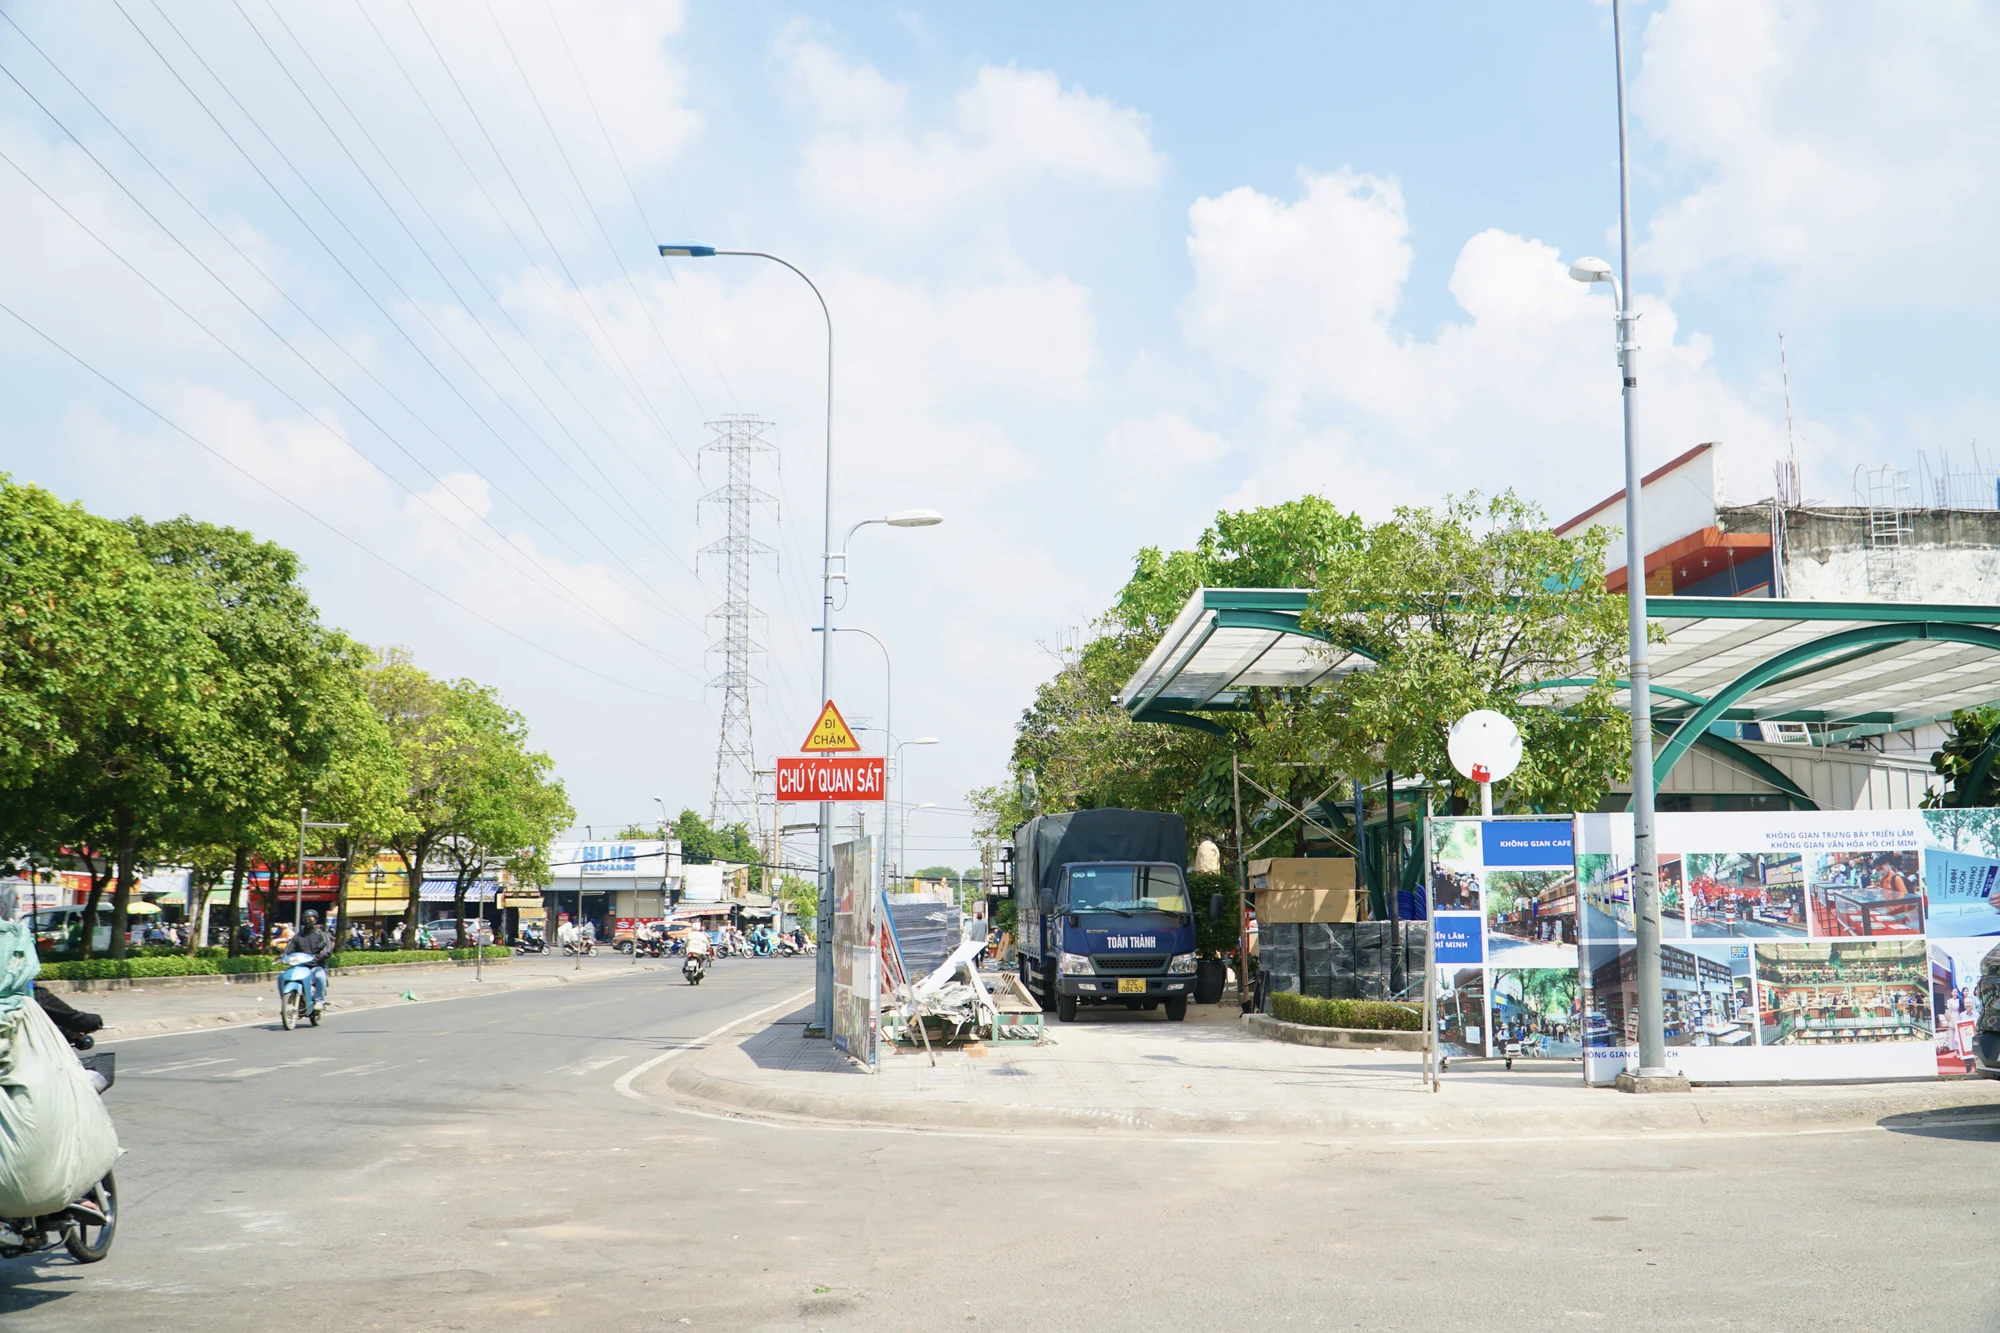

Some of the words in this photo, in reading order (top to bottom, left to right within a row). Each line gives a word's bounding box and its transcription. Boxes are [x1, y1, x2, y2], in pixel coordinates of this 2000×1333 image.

[825, 719, 836, 729] ĐI
[779, 763, 805, 793] CHÚ
[807, 762, 816, 792] Ý
[818, 768, 854, 793] QUAN
[857, 762, 882, 792] SÁT
[1765, 831, 1796, 839] KHÔNG
[1853, 830, 1870, 838] BÀY
[1500, 839, 1529, 847] KHÔNG
[1770, 840, 1801, 849] KHÔNG
[1803, 841, 1825, 849] GIAN
[1846, 840, 1864, 848] HÓA
[1880, 839, 1895, 847] CHÍ
[583, 863, 636, 871] EXCHANGE
[1447, 931, 1465, 940] LÃM
[1106, 934, 1128, 948] TOÀN
[1129, 934, 1156, 948] THÀNH
[1435, 940, 1444, 948] HÍ
[1585, 1050, 1607, 1058] ÔNG
